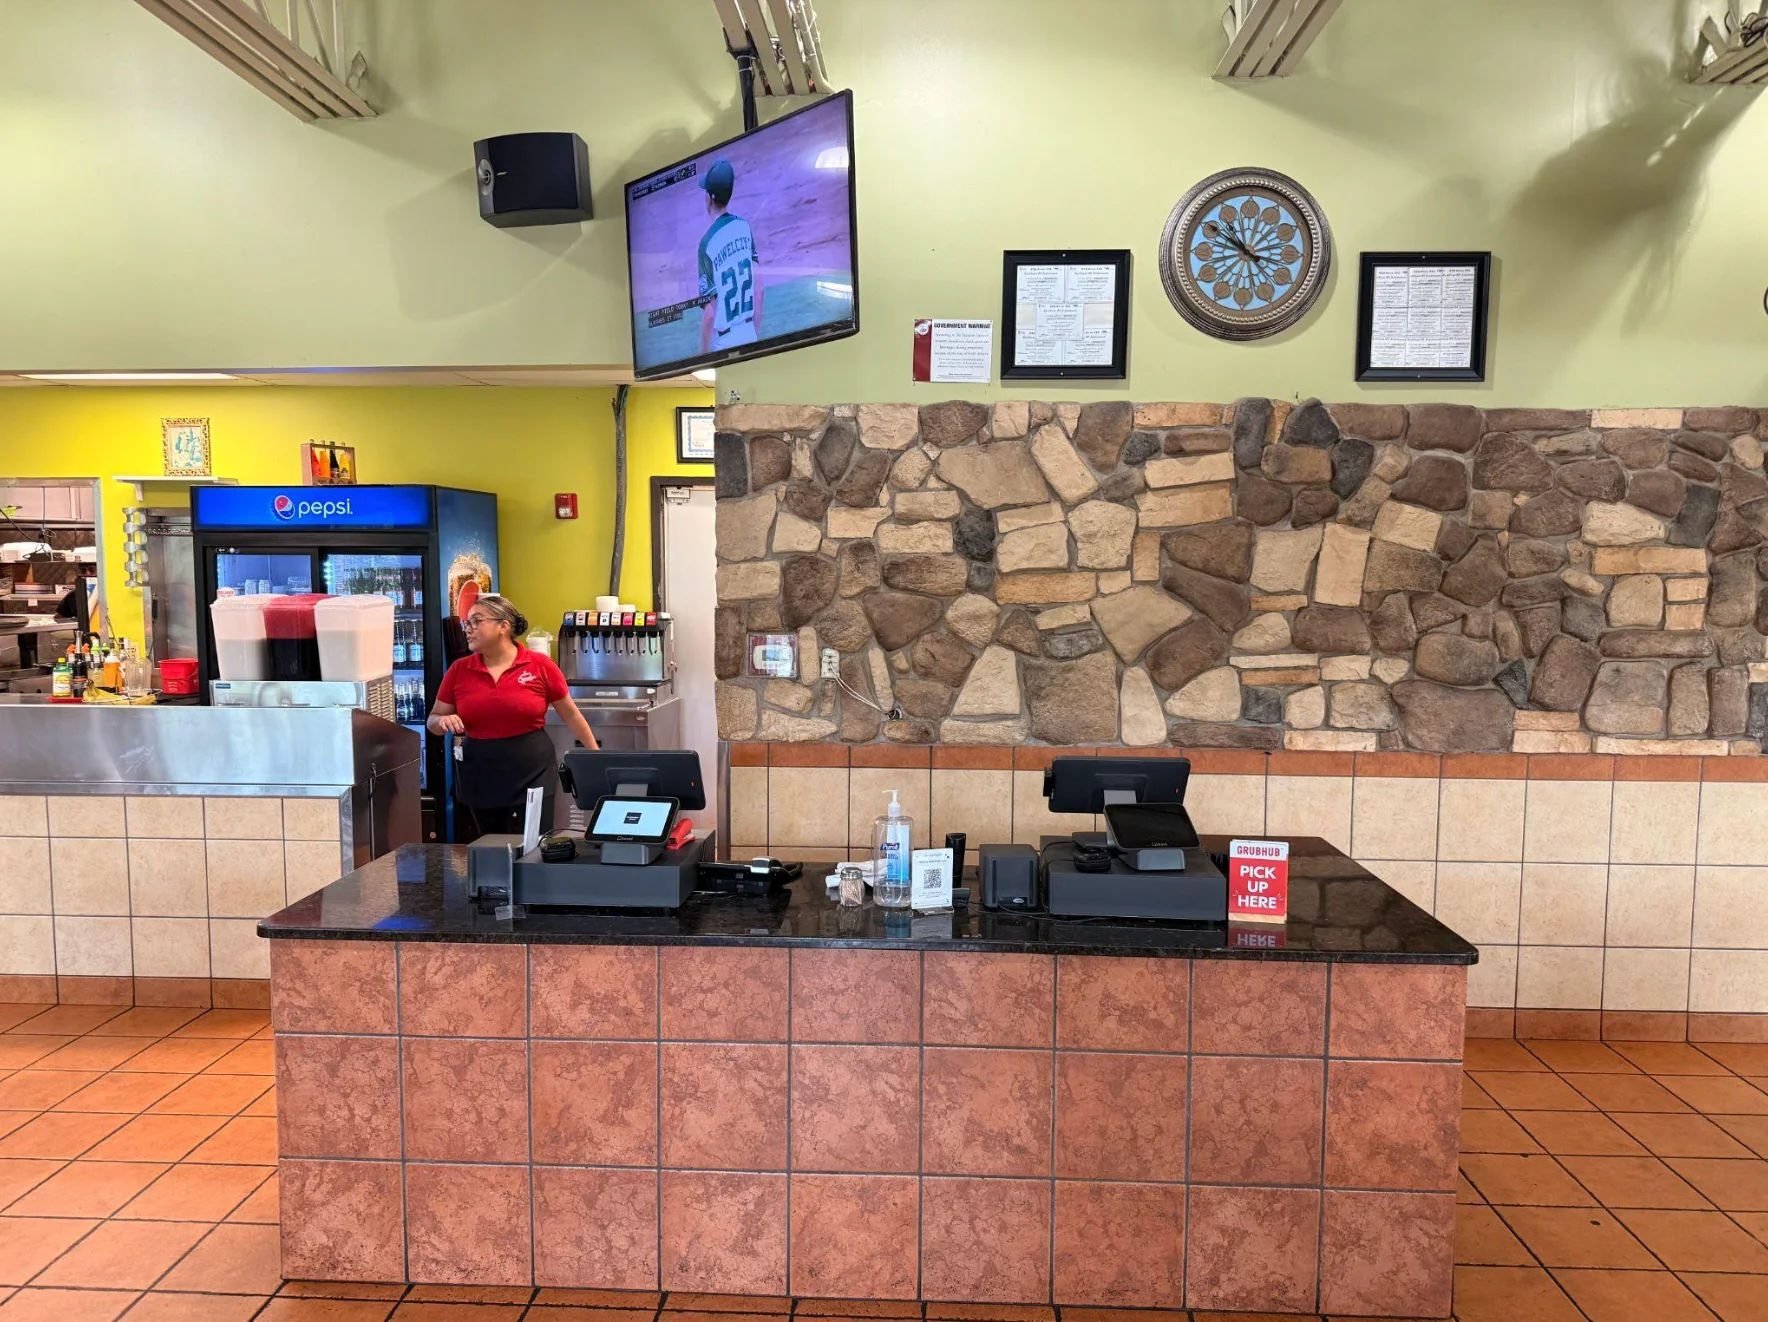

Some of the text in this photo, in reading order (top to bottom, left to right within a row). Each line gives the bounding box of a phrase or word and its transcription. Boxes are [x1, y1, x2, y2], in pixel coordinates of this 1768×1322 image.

[721, 257, 753, 322] 22
[1236, 845, 1281, 857] GRUBHUB
[1239, 865, 1277, 880] PICK
[1247, 880, 1269, 893] UP
[1237, 894, 1277, 909] HERE
